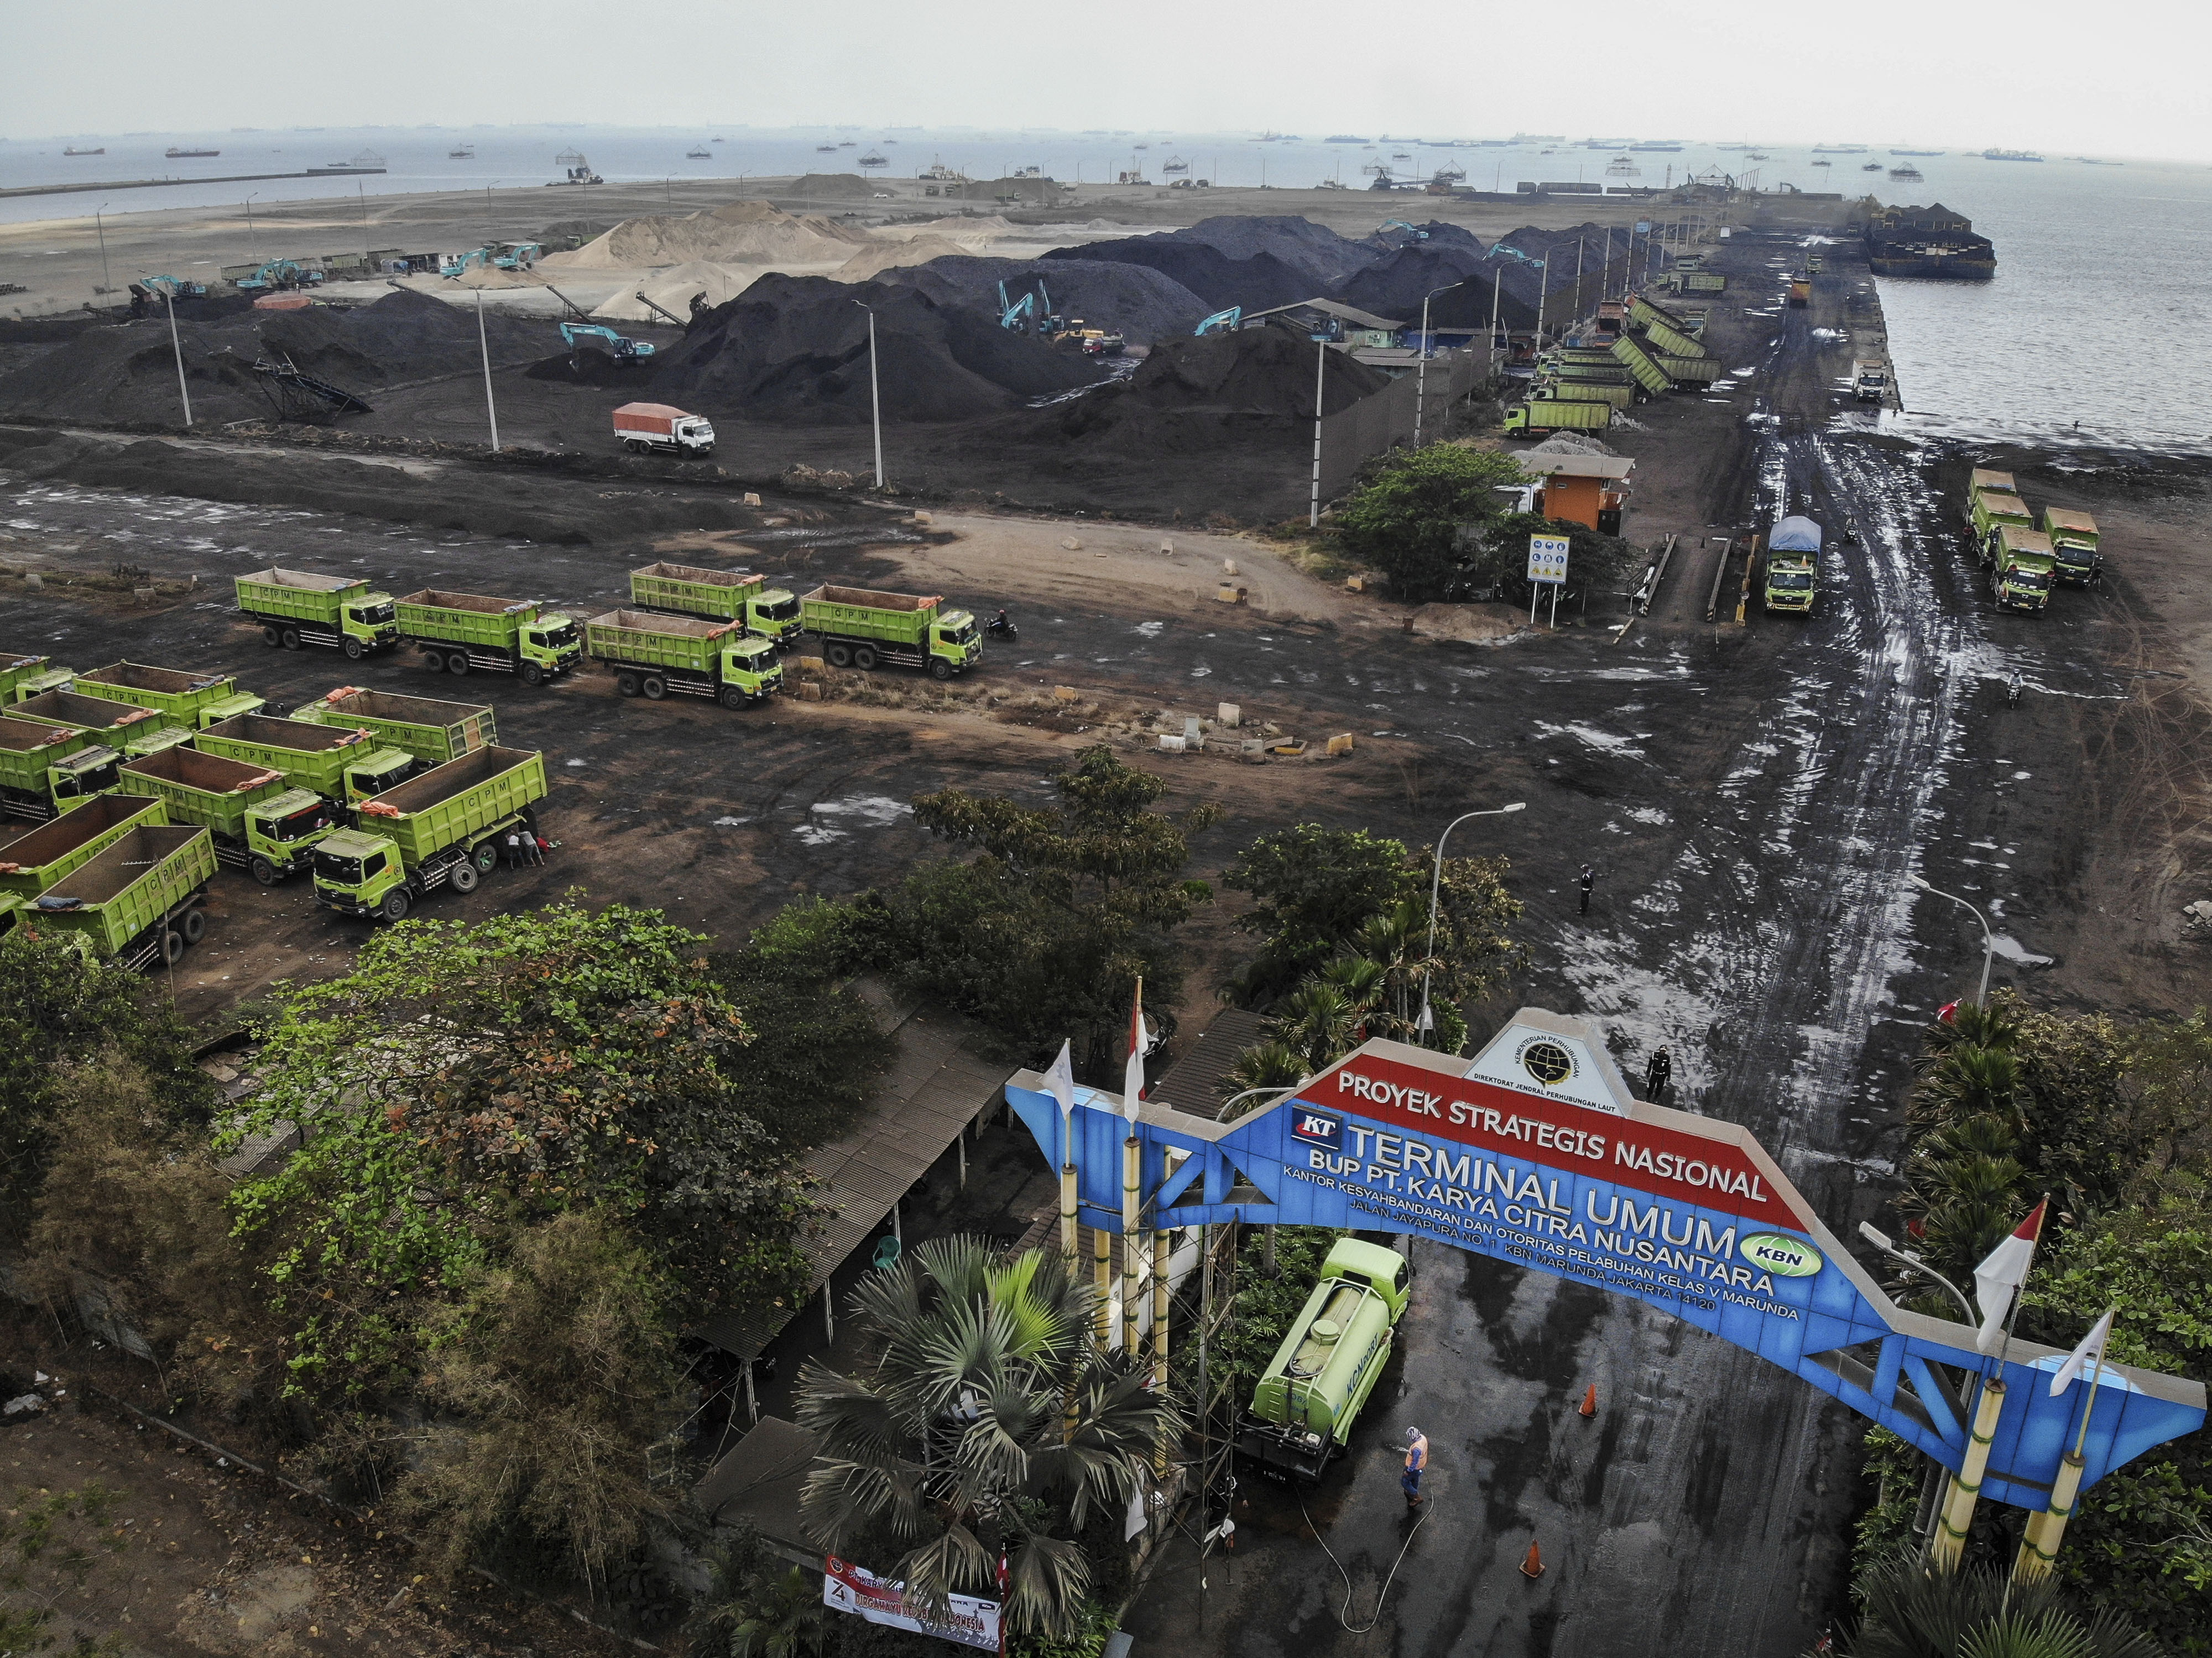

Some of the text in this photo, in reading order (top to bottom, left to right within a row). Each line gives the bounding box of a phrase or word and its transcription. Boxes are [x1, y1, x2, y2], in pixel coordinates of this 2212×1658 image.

[1474, 1073, 1616, 1113] DIREKTORAT JENDRAL PERHUBUNGAN LAUT
[1514, 1035, 1580, 1079] KEMENTERIAN PERHUBUNGAN
[1301, 1115, 1335, 1137] KT
[1339, 1070, 1767, 1202] PROYEK STRATEGIS NASIONAL
[1310, 1149, 1361, 1177] BUP
[1408, 1176, 1499, 1220] KARYA
[1504, 1204, 1587, 1245] CITRA
[1594, 1227, 1774, 1297] NUSANTARA
[1348, 1124, 1736, 1260] TERMINAL UMUM
[1283, 1165, 1799, 1322] KANTOR KESYAHBANDARAN DAN OTORITAS PELABUHAN KELAS V MARUNDA
[1349, 1200, 1390, 1218] JALAN
[1392, 1212, 1459, 1239] JAYAPURA
[1490, 1239, 1495, 1249] 1
[1504, 1243, 1532, 1260] KBN
[1535, 1250, 1605, 1282] MARUNDA
[1608, 1274, 1672, 1300] JAKARTA
[1677, 1292, 1715, 1312] 14120
[1754, 1245, 1806, 1267] KBN
[855, 1592, 902, 1616] DIRGAHAYU
